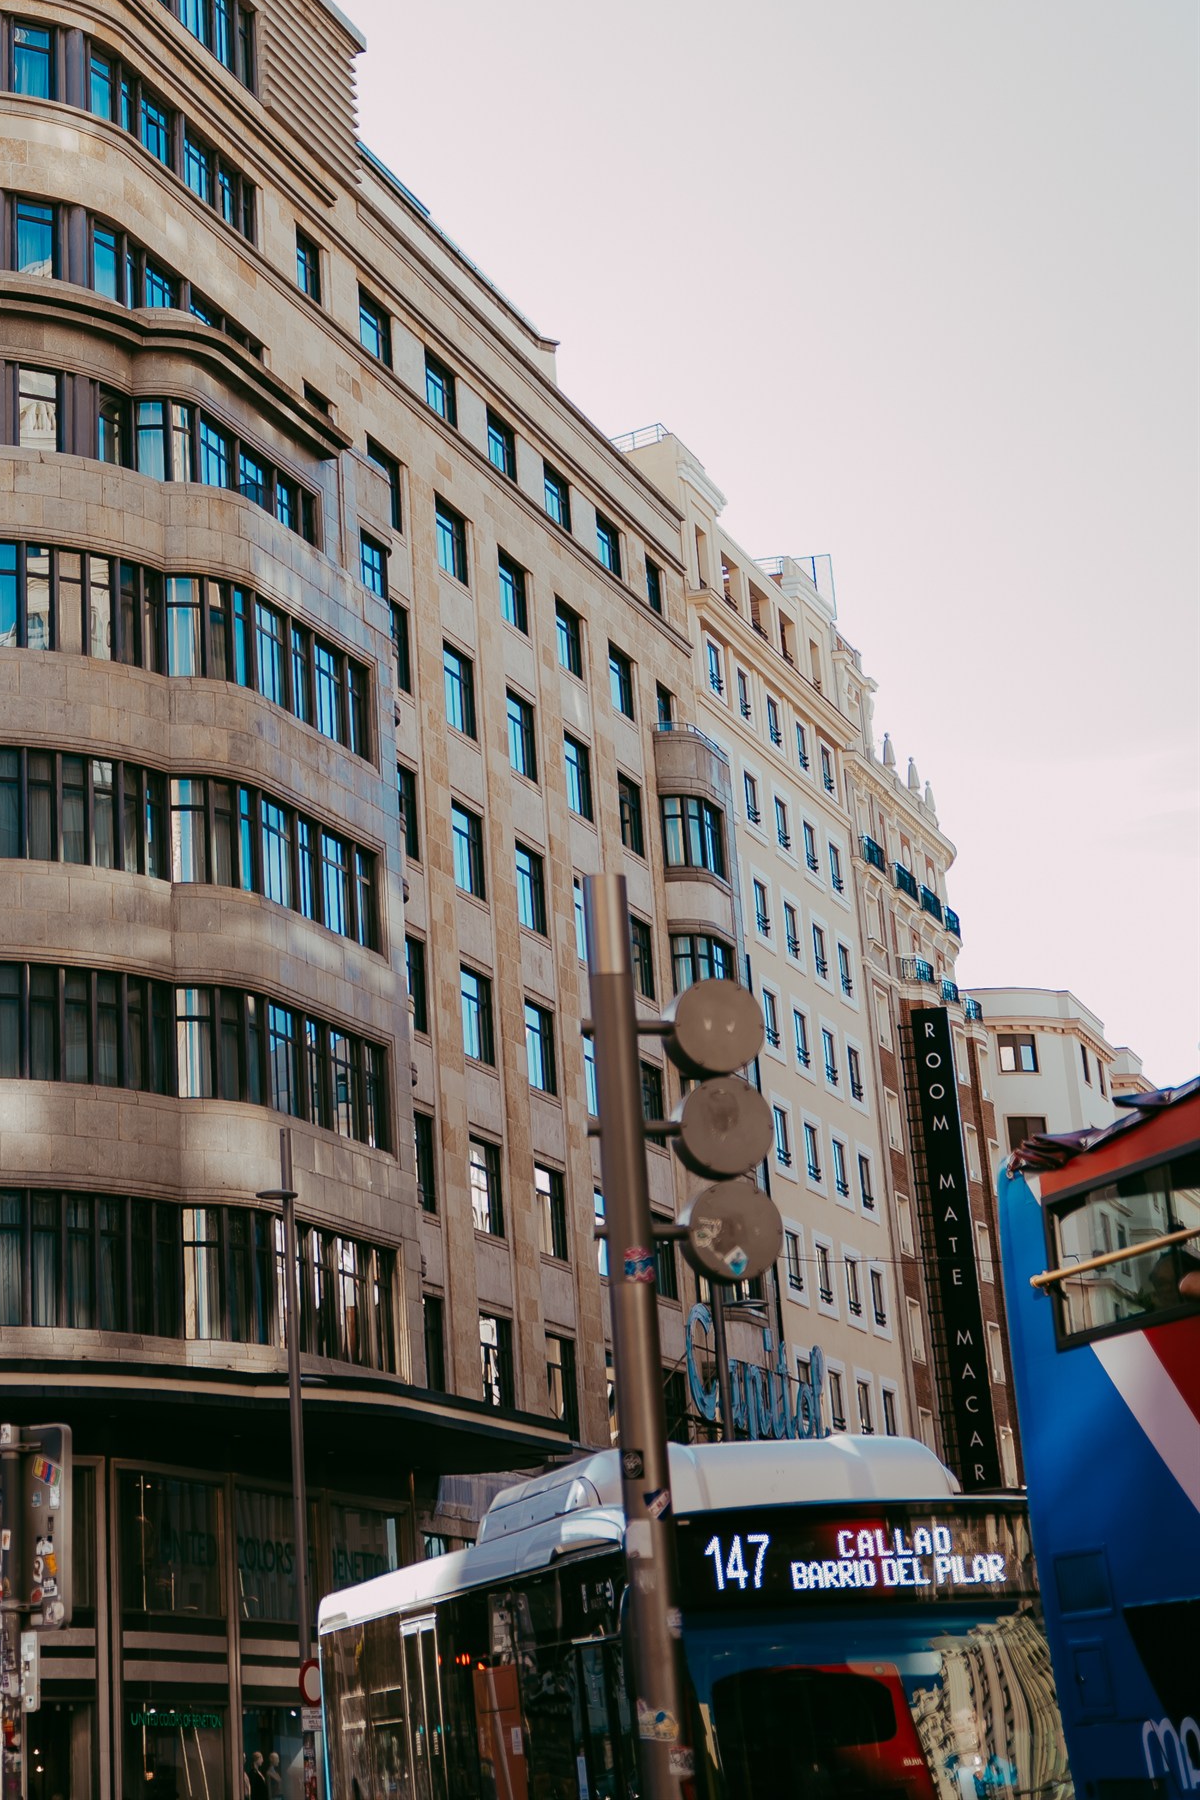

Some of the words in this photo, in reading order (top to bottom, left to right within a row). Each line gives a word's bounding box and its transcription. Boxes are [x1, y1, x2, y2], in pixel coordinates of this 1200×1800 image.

[925, 1023, 949, 1131] ROOM
[939, 1174, 963, 1285] MATE
[705, 1534, 769, 1590] 147
[790, 1559, 877, 1589] BARRIO
[881, 1558, 931, 1586] DEL
[935, 1554, 1007, 1584] PILAR
